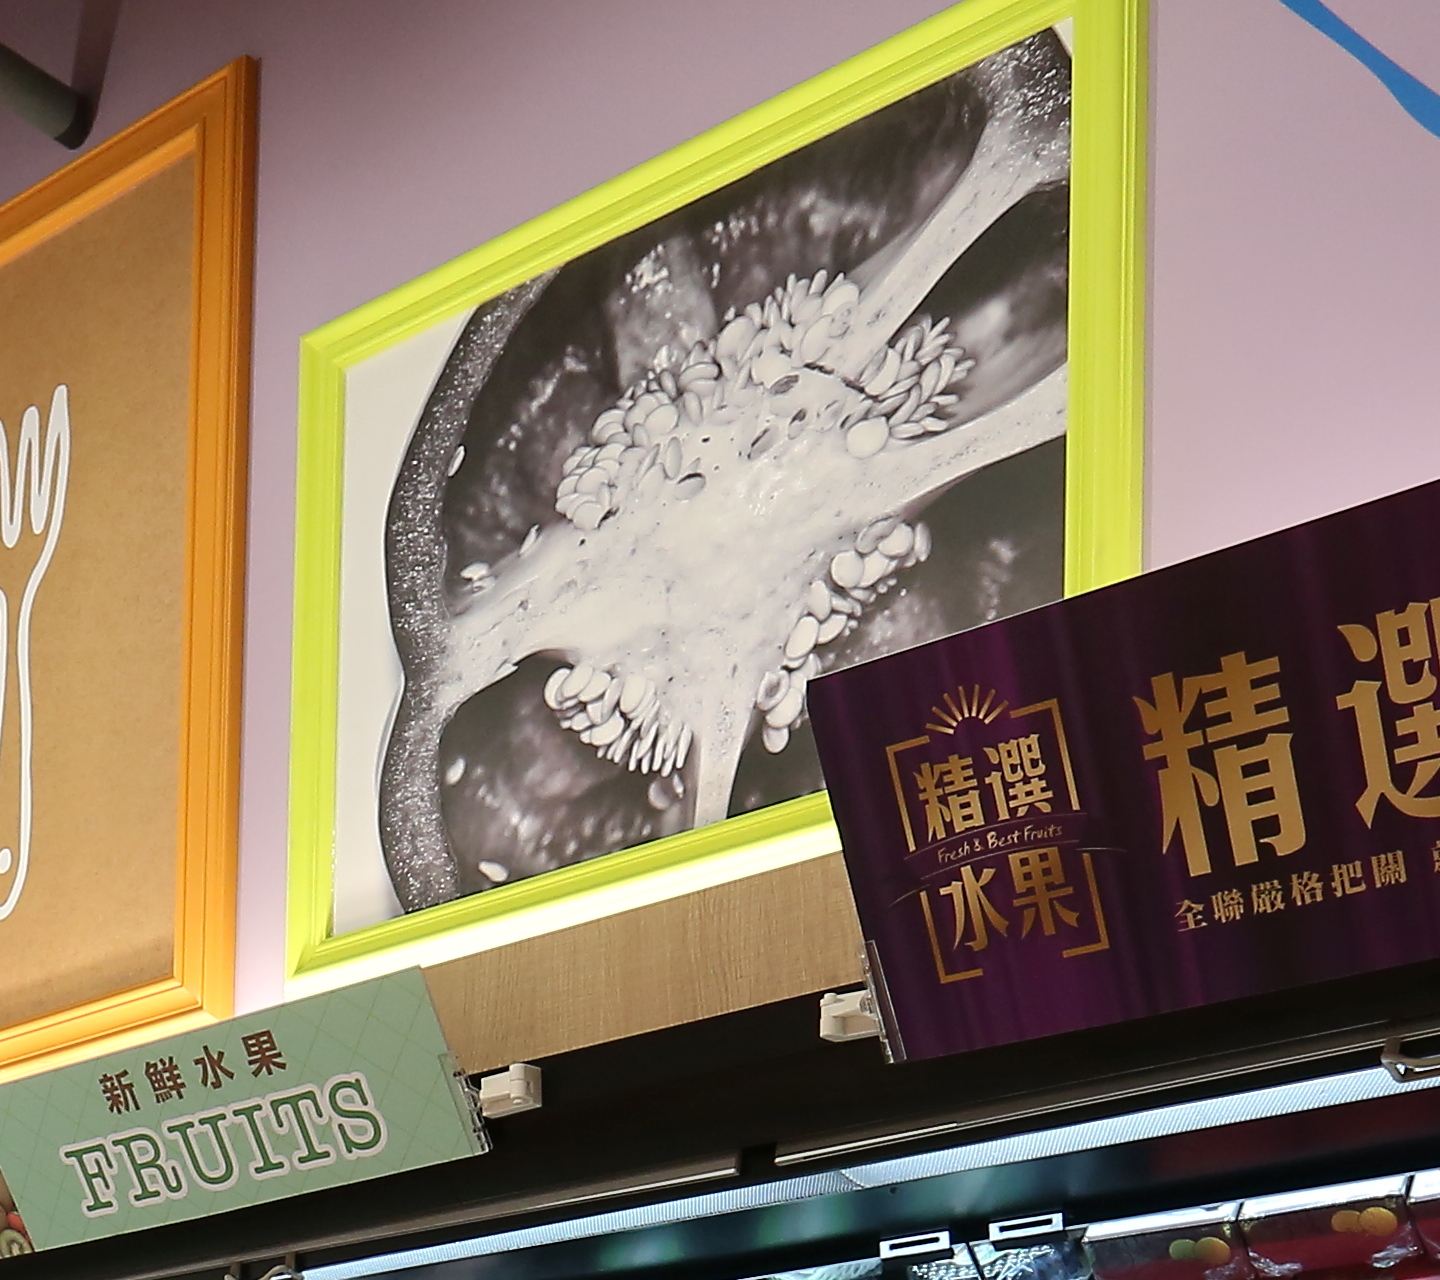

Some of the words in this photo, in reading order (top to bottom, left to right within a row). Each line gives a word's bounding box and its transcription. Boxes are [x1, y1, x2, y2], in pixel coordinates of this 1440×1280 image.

[912, 734, 1054, 842] 精選
[938, 844, 971, 863] Fresh
[986, 829, 1022, 850] Best
[1024, 823, 1063, 842] Fruits
[1175, 848, 1408, 932] 全聯嚴格把關
[939, 847, 1080, 951] 水果
[100, 1030, 287, 1114] 新鮮水果
[60, 1073, 387, 1218] FRUITS
